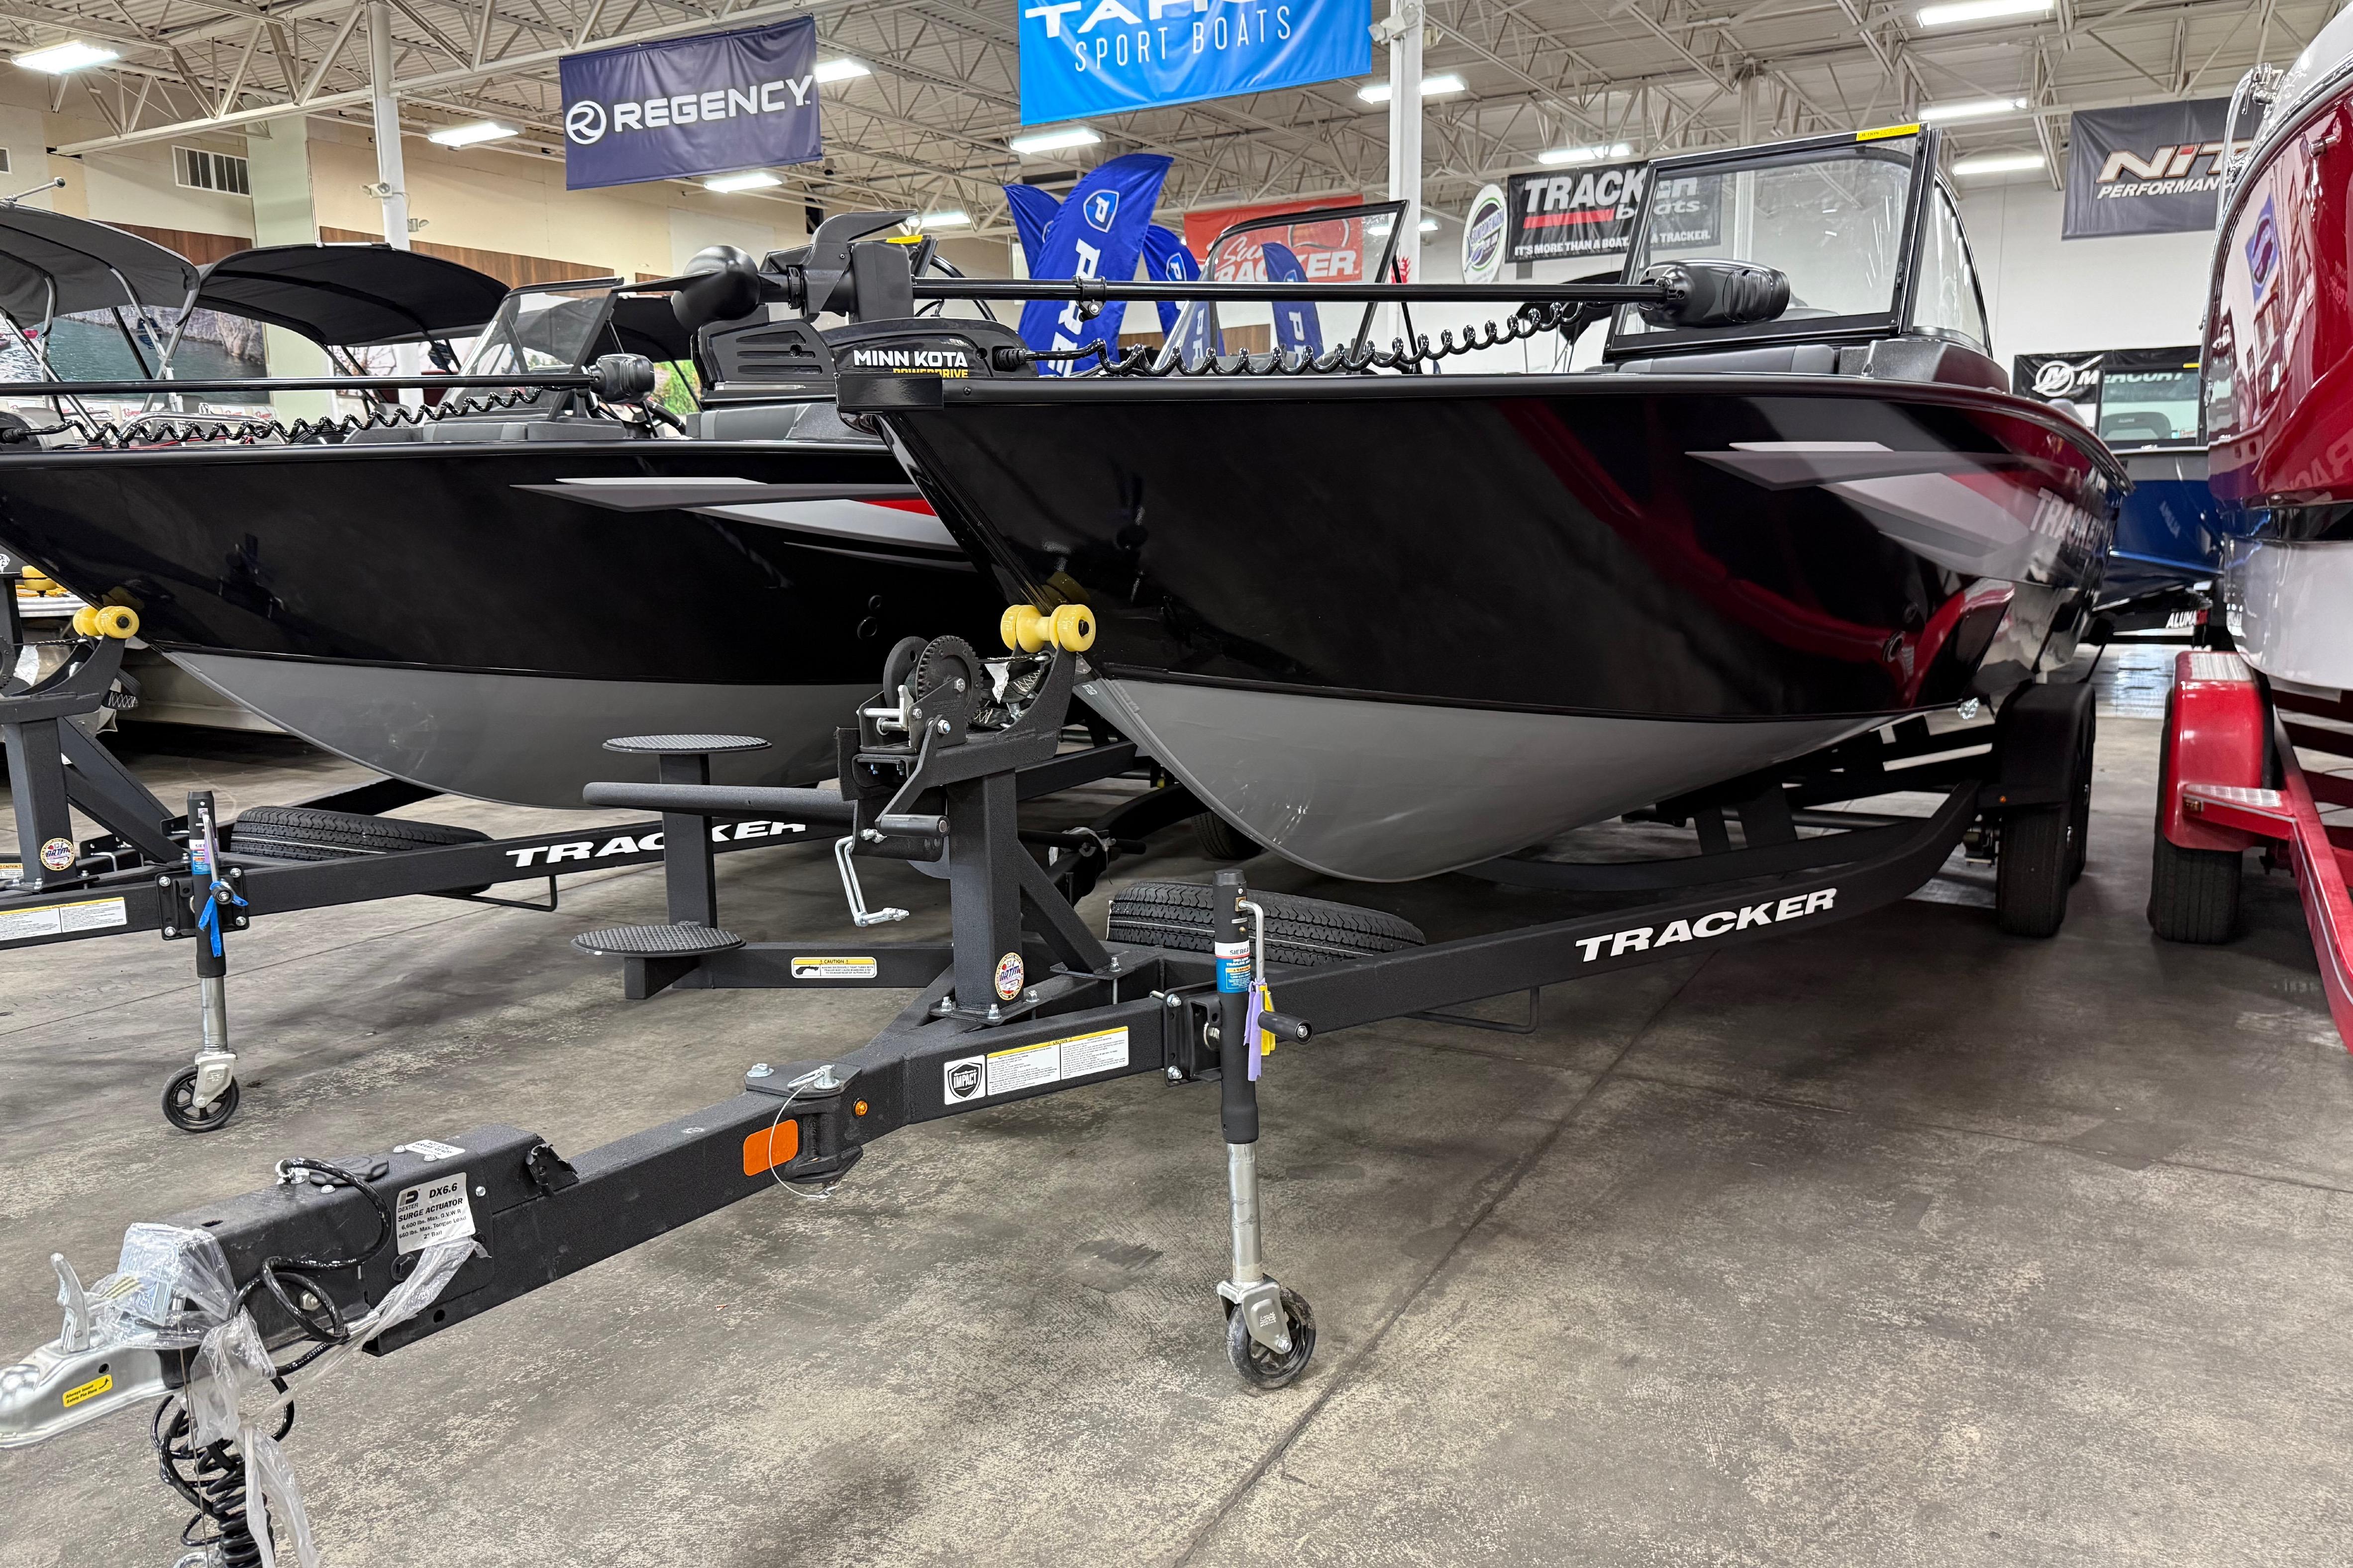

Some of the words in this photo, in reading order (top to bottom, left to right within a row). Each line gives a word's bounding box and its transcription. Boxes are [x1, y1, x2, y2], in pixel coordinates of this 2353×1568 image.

[1025, 0, 1261, 38] TAH
[1075, 27, 1168, 72] SPORT
[1193, 6, 1291, 54] BOATS
[614, 75, 813, 132] REGENCY
[2097, 177, 2233, 199] PERFORMANC
[1616, 199, 1700, 220] bats
[1660, 229, 1711, 244] TRACKER.
[1514, 245, 1533, 256] IT'S
[1535, 242, 1563, 255] MORE
[1564, 240, 1592, 252] THAN
[1593, 239, 1601, 249] A
[853, 350, 910, 367] MINN
[914, 351, 968, 367] KOTA
[1575, 887, 1837, 963] TRACKER
[953, 1072, 977, 1089] IMPACT
[429, 1182, 458, 1198] DX6.6
[398, 1202, 418, 1213] DEXTER
[398, 1209, 424, 1222] SURGE
[425, 1198, 463, 1214] ACTUATOR
[402, 1221, 416, 1230] 6,600
[66, 1390, 81, 1399] Always
